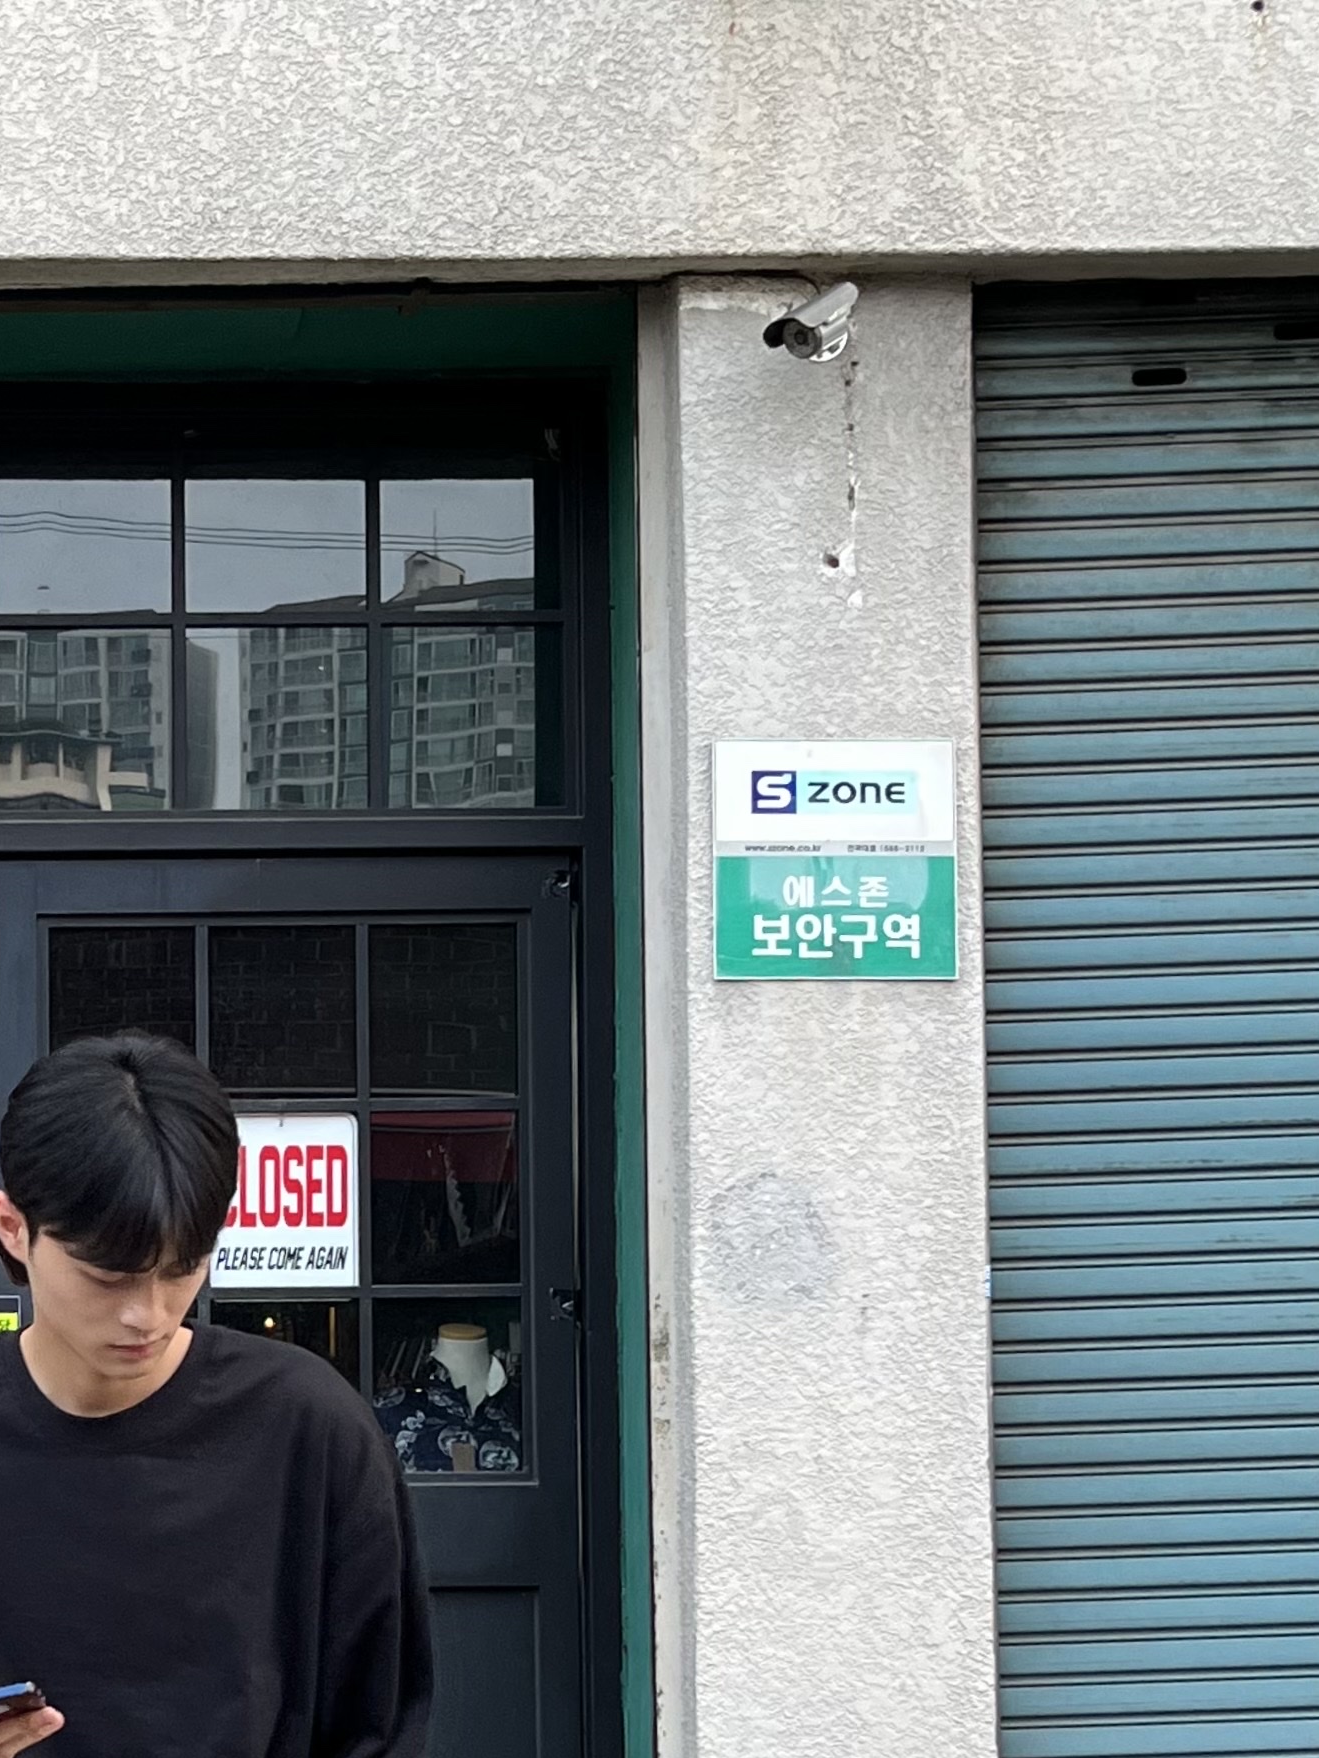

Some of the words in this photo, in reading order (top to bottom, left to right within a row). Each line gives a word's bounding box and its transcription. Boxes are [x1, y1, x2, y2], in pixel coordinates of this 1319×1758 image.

[782, 875, 889, 908] 에스존
[751, 913, 921, 959] 보안구역
[223, 1145, 348, 1228] LOSED
[215, 1246, 267, 1271] PLEASE
[267, 1246, 305, 1271] COME
[305, 1246, 349, 1271] AGAIN
